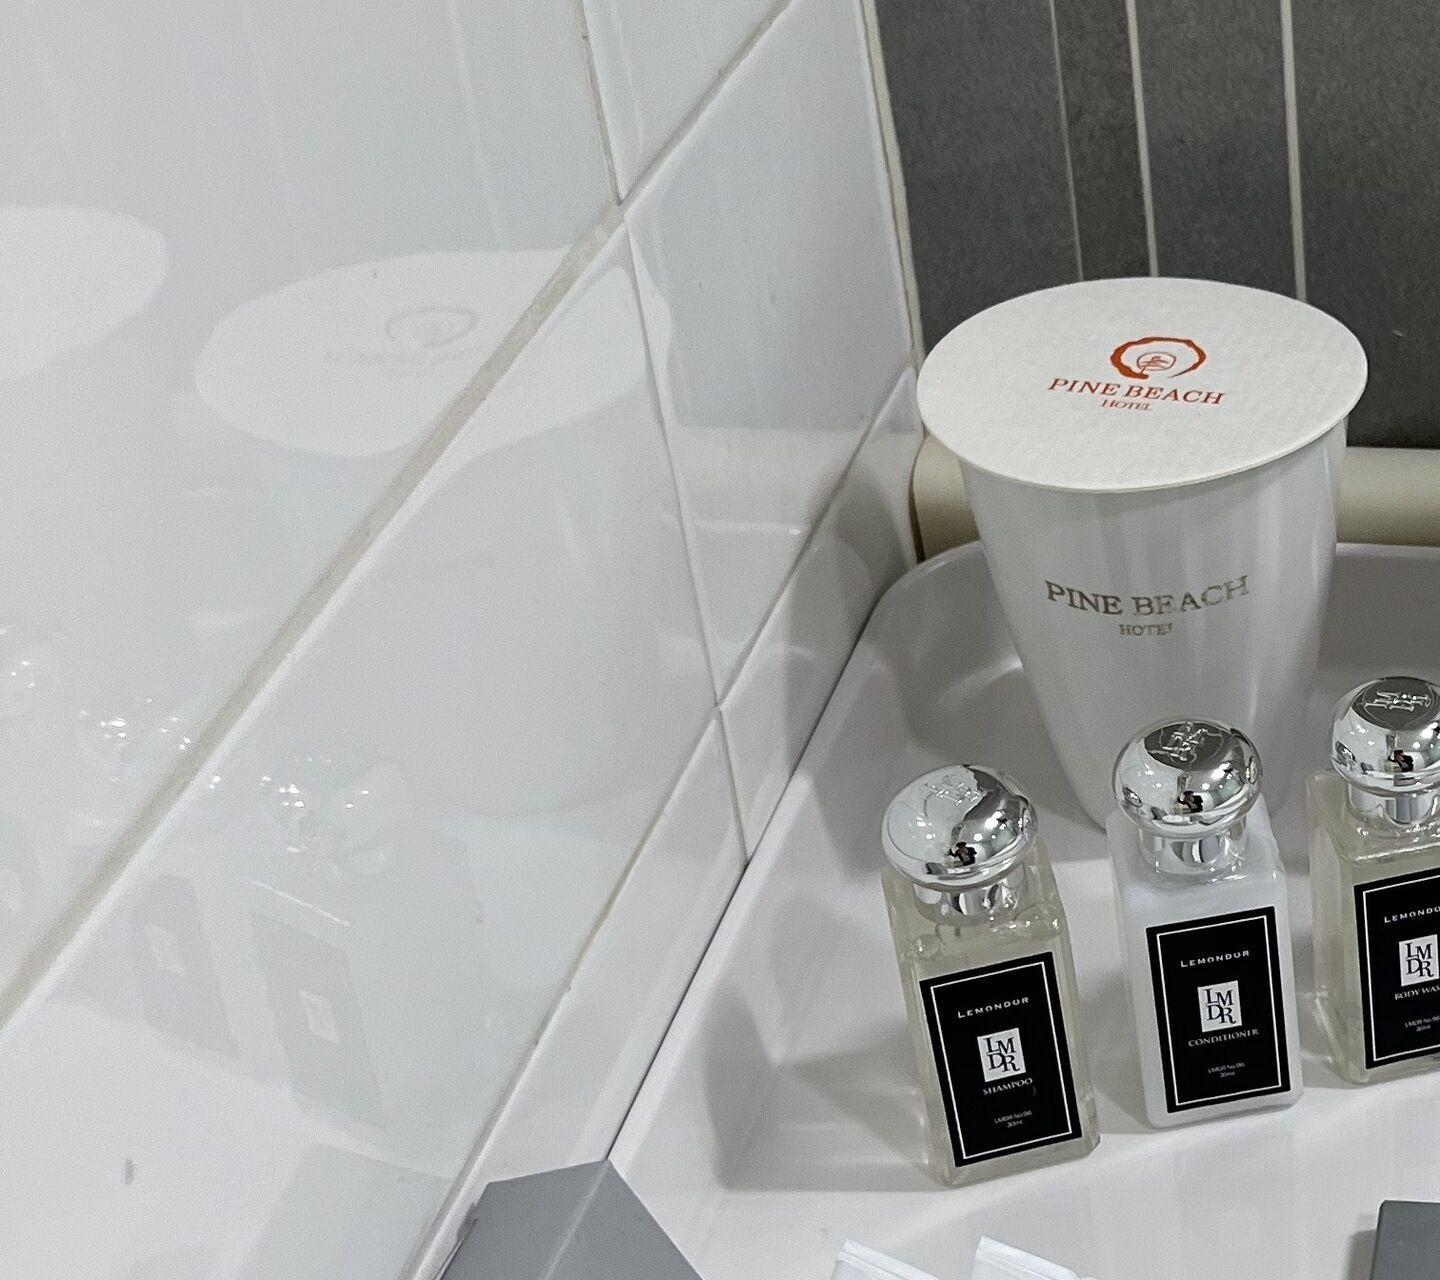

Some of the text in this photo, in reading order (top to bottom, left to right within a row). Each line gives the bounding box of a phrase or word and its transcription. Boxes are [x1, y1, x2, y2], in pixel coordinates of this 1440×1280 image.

[1048, 377, 1226, 405] PINE BEACH
[1045, 575, 1249, 616] PINE BEACH
[1394, 988, 1420, 1000] BODY
[1188, 1028, 1260, 1047] CONDITIONER
[982, 1078, 1033, 1096] SHAMPOO
